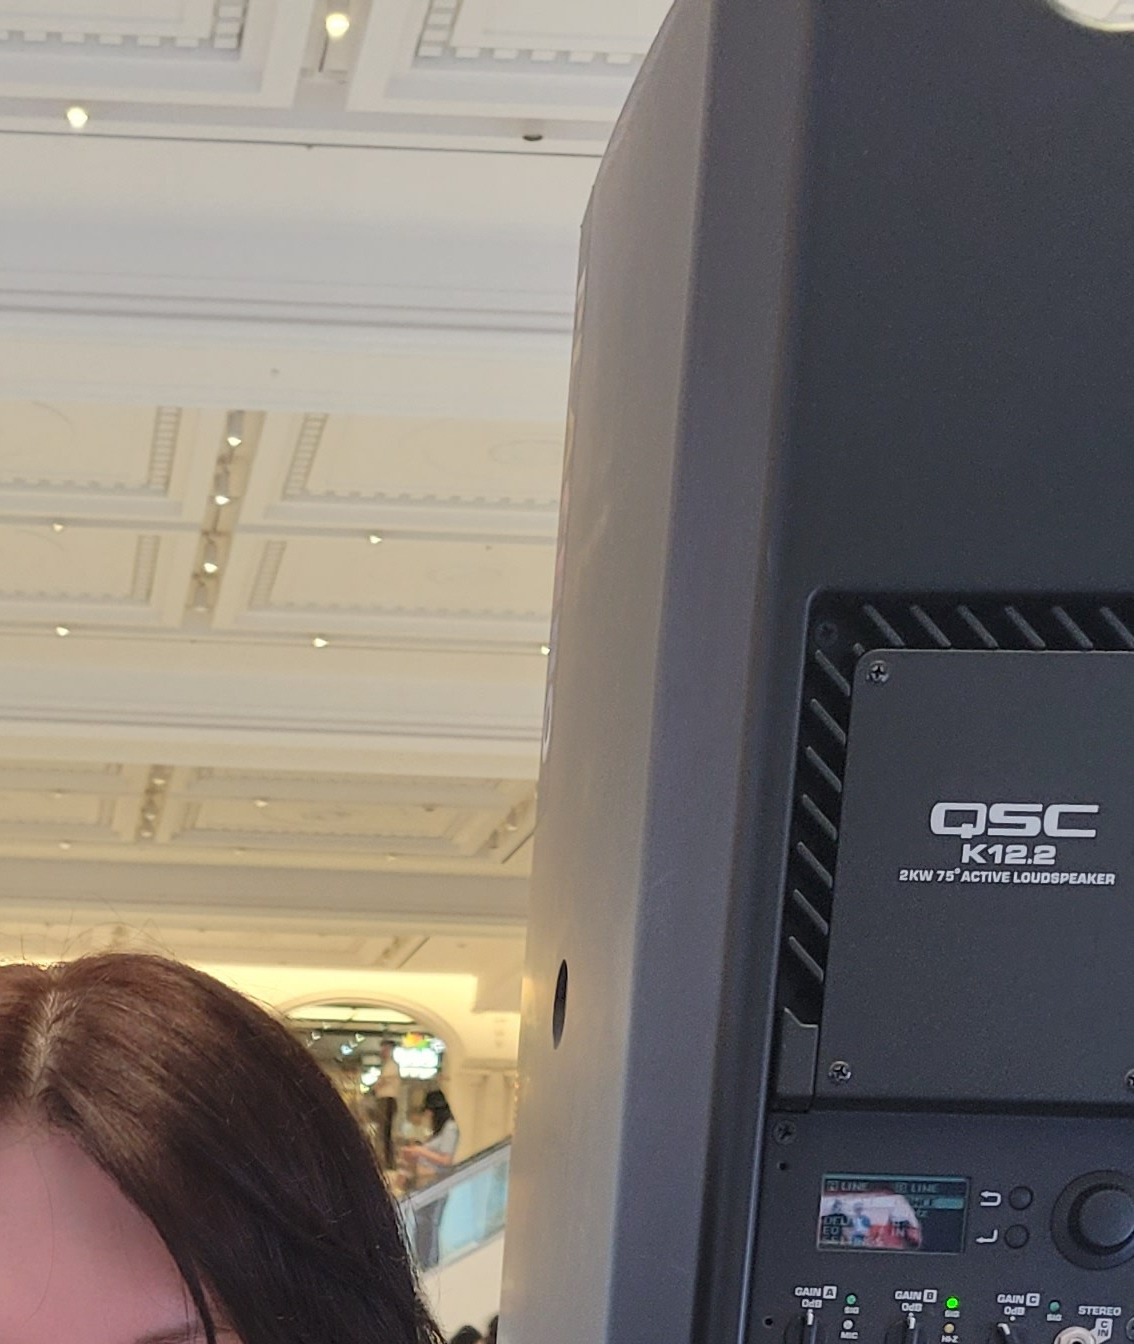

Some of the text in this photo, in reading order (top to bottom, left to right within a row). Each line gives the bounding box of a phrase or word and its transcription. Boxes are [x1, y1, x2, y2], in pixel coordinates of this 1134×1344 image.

[930, 802, 1099, 838] QSC
[962, 843, 1057, 865] K12.2
[899, 869, 932, 882] 2KW
[961, 870, 1010, 884] ACTIVE
[1013, 871, 1116, 886] LOUDSPEAKER
[795, 1287, 821, 1296] GAIN
[895, 1291, 922, 1300] GAIN
[997, 1294, 1024, 1303] GAIN
[1078, 1306, 1121, 1316] STEREO
[1098, 1329, 1109, 1337] IN
